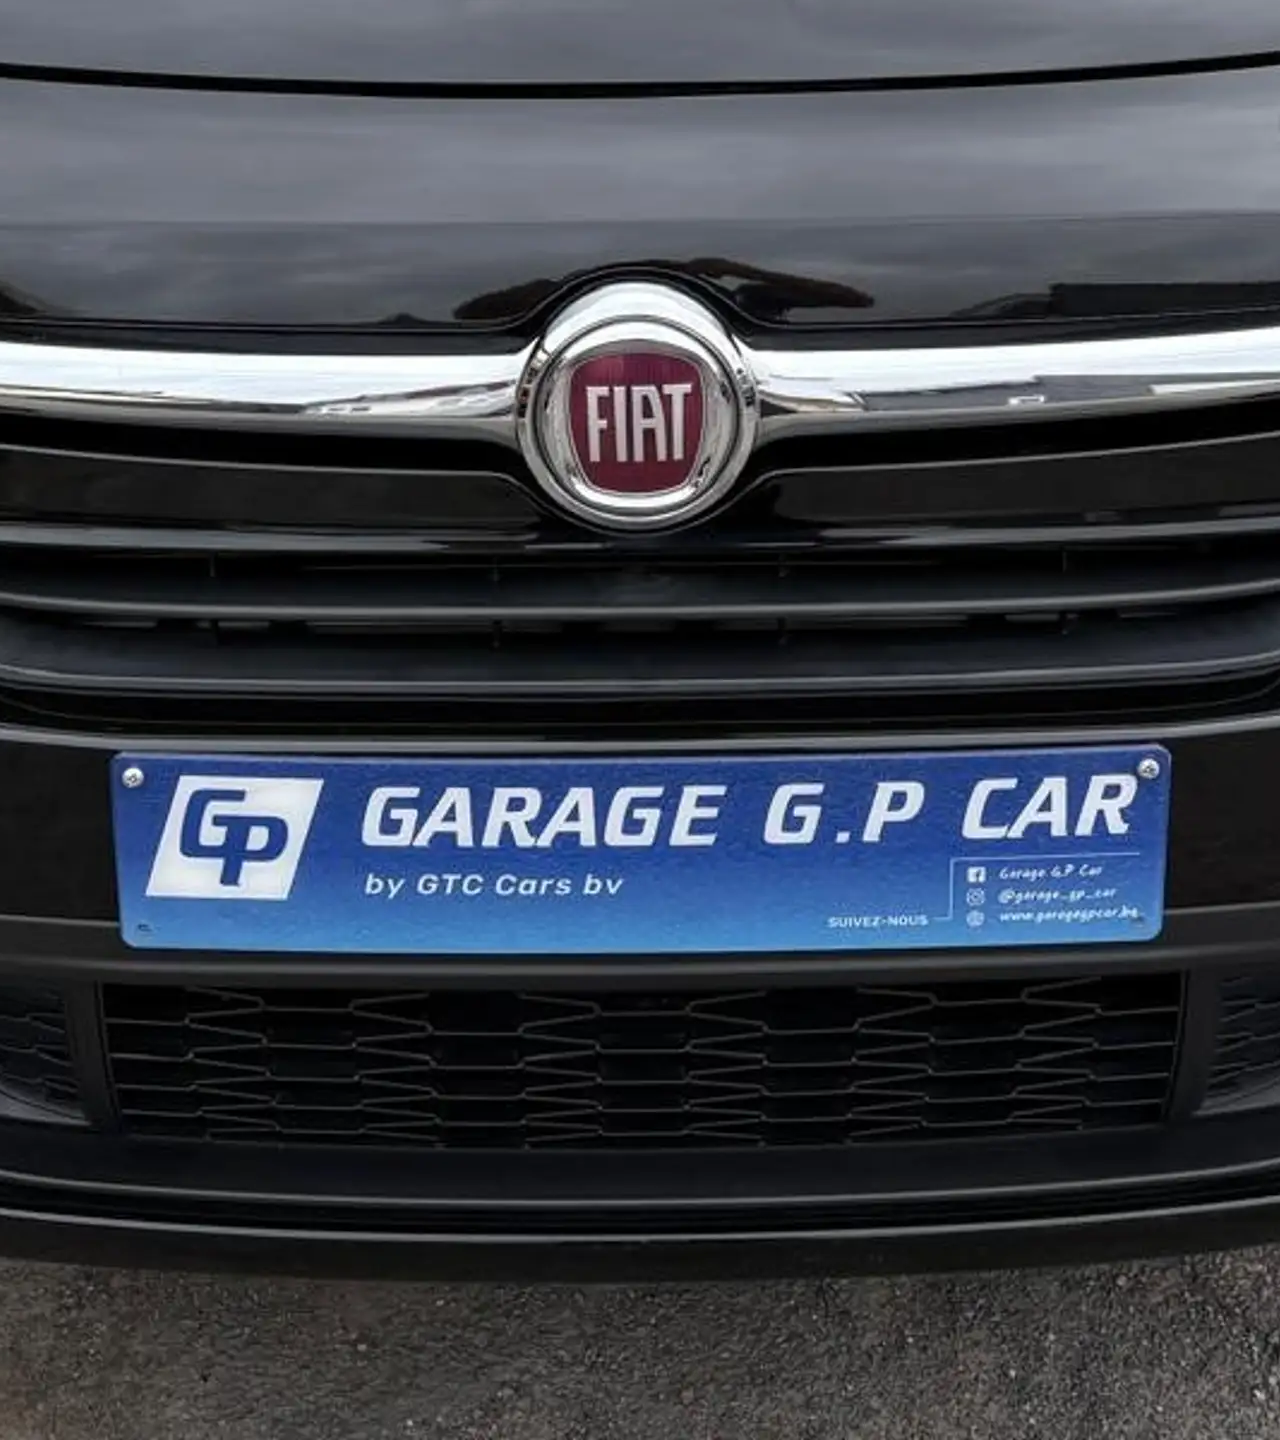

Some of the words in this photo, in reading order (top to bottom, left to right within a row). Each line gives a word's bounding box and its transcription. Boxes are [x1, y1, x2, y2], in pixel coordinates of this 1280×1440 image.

[585, 382, 694, 463] FIAT
[361, 783, 727, 848] GARAGE
[762, 781, 925, 845] G.P
[961, 774, 1137, 840] CAR
[178, 788, 290, 887] GP
[364, 873, 405, 899] by
[417, 873, 483, 896] GTC
[494, 873, 571, 896] Cars
[583, 872, 624, 896] bv
[998, 865, 1047, 882] Garage
[1078, 863, 1103, 877] Car
[827, 914, 929, 929] SUIVEZ-NOUS
